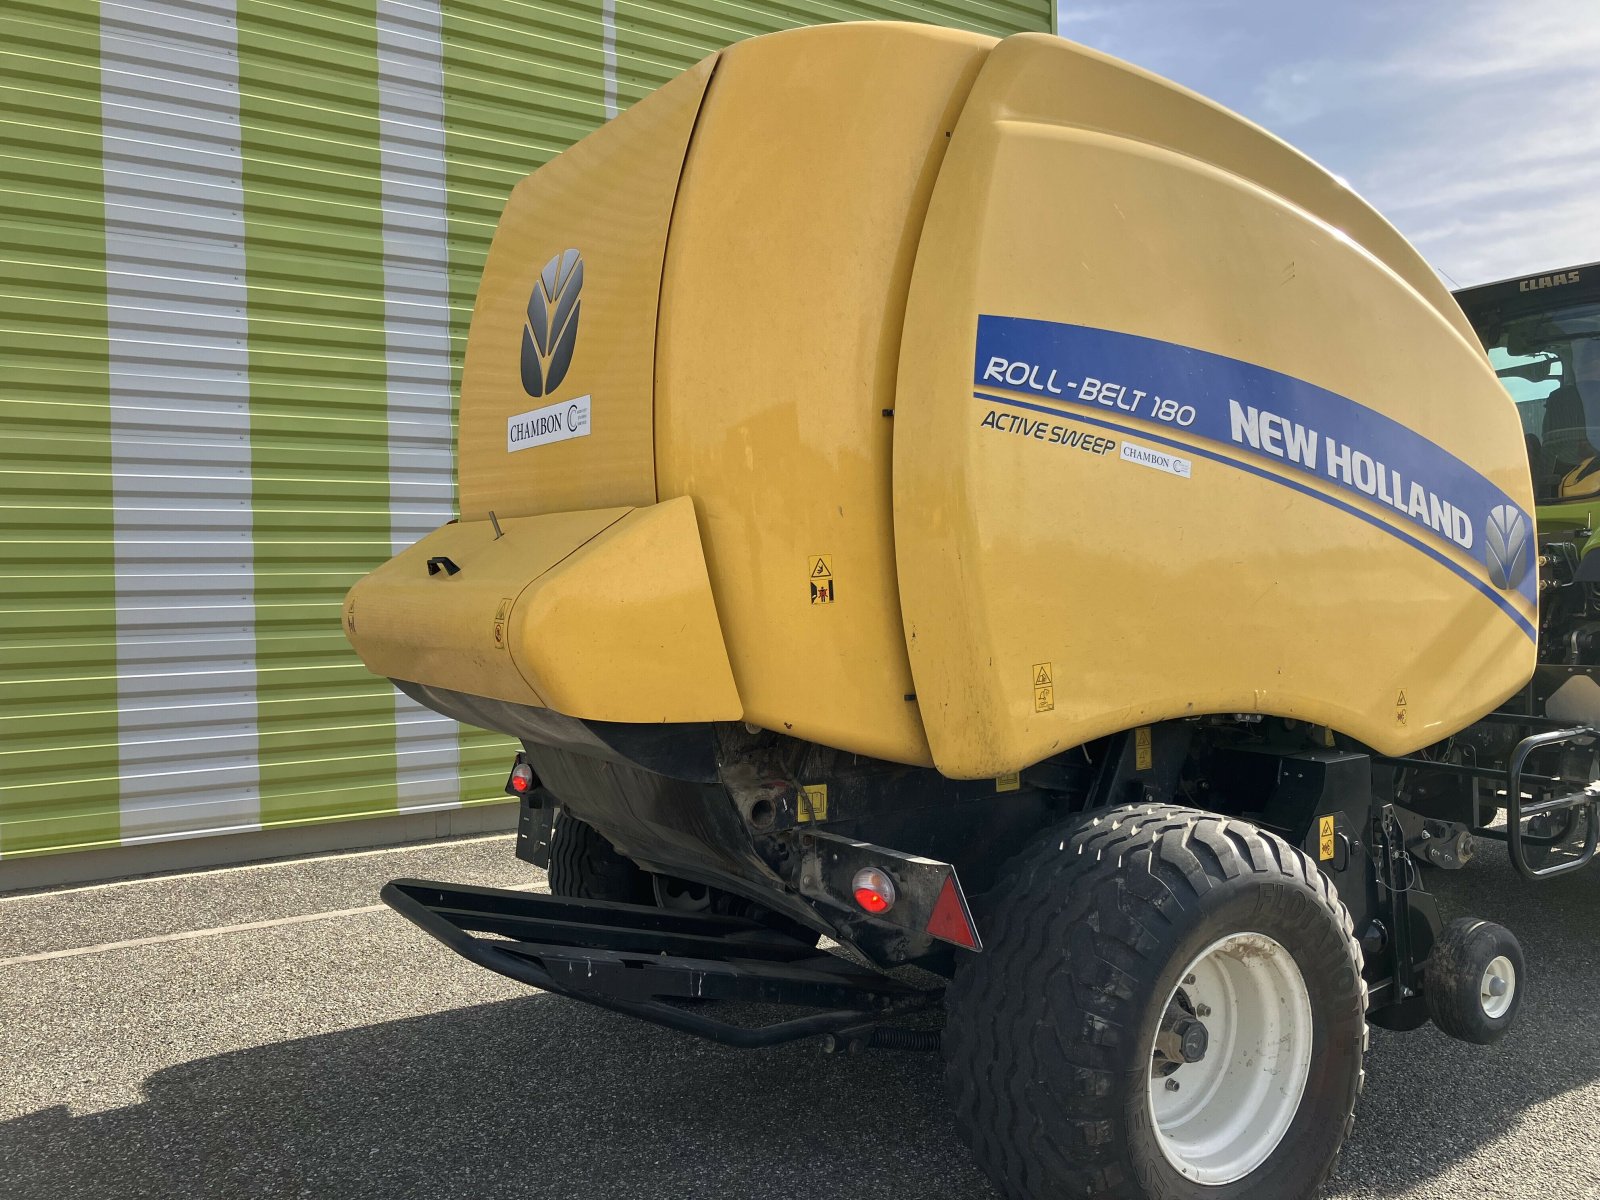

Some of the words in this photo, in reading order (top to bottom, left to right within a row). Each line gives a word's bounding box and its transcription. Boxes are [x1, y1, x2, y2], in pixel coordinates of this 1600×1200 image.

[1519, 271, 1580, 292] CLAAS
[1150, 396, 1197, 427] 180
[510, 412, 563, 442] CHAMBON
[981, 410, 1049, 440] ACTIVE
[1048, 425, 1117, 456] SWEEP
[1123, 446, 1170, 468] CHAMBON
[1228, 398, 1318, 470] NEW
[1325, 436, 1474, 549] HOLLAND
